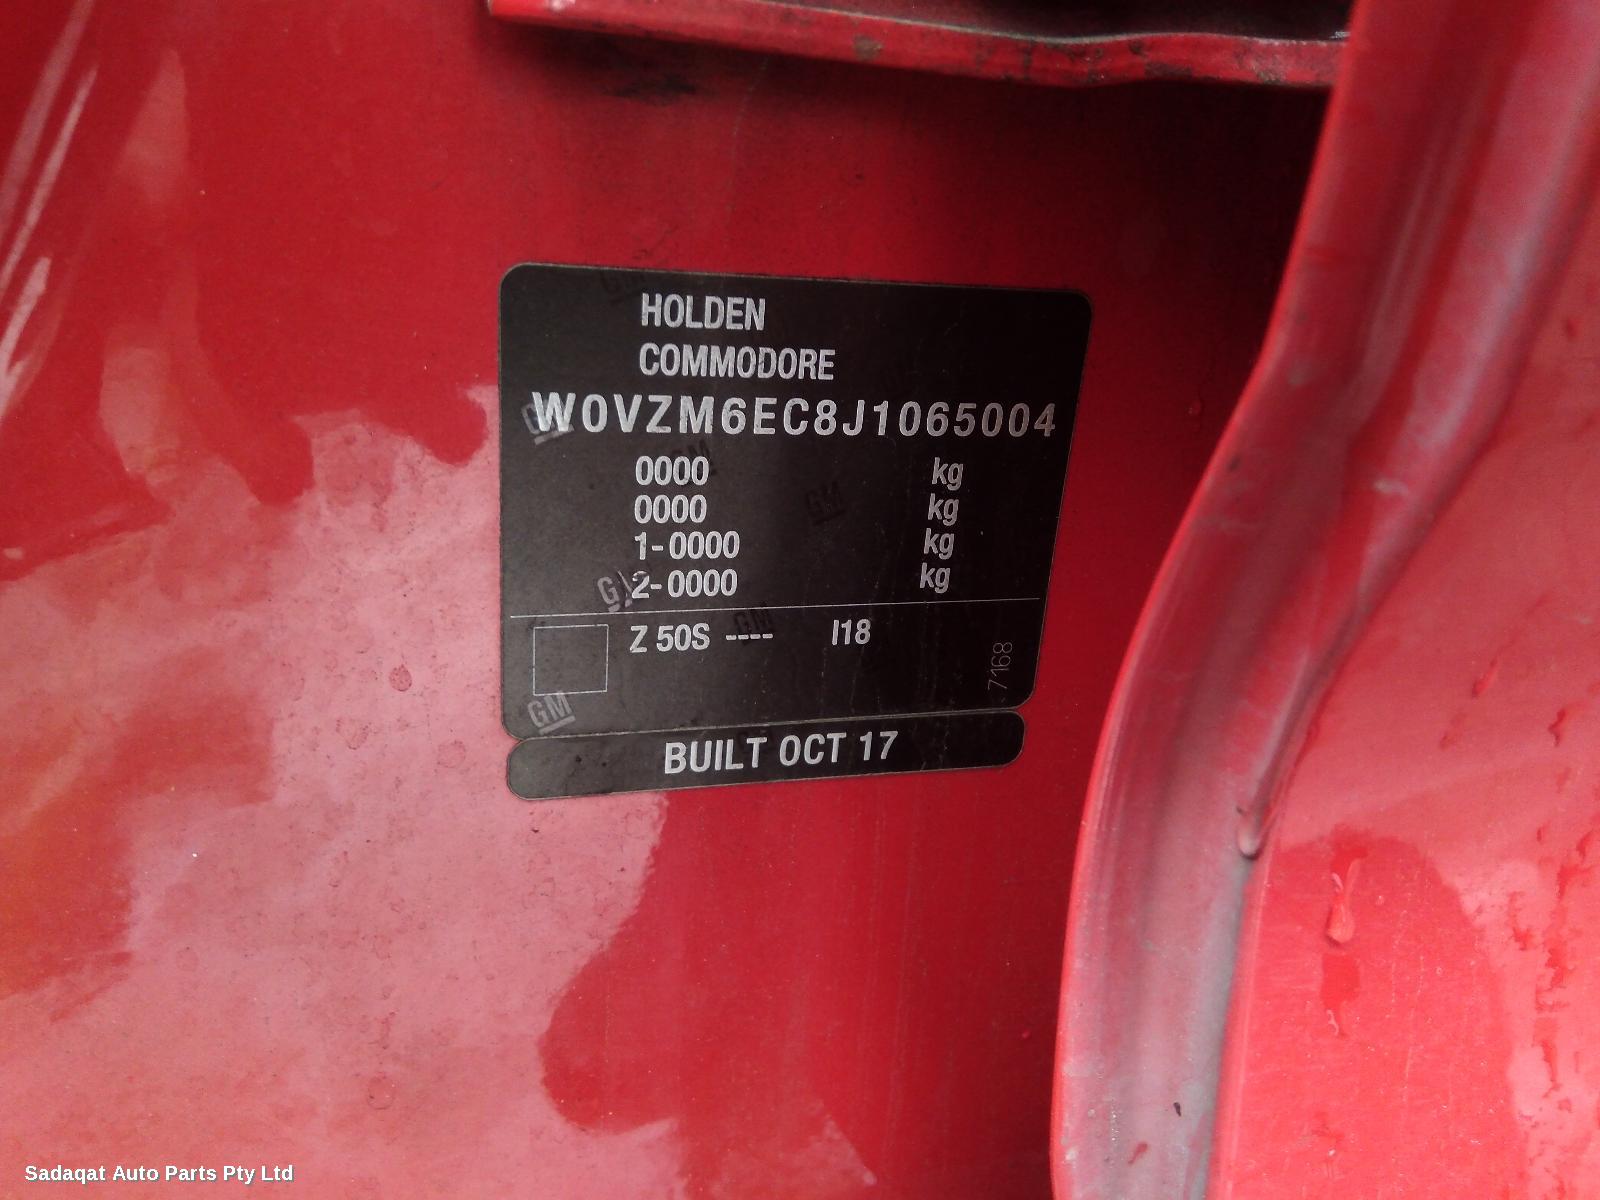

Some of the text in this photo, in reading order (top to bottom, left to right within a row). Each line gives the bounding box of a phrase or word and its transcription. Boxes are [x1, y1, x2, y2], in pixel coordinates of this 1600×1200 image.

[641, 293, 766, 331] HOLDEN
[639, 343, 835, 381] COMMODORE
[635, 455, 710, 486] 0000
[931, 456, 964, 491] kg
[634, 492, 960, 526] 0000 kg
[923, 527, 955, 560] kg
[919, 562, 951, 593] kg
[629, 624, 648, 654] Z
[656, 622, 711, 652] 50S
[987, 641, 1013, 691] 7168
[664, 736, 768, 775] BUILT
[778, 732, 847, 767] OCT
[859, 730, 899, 762] 17
